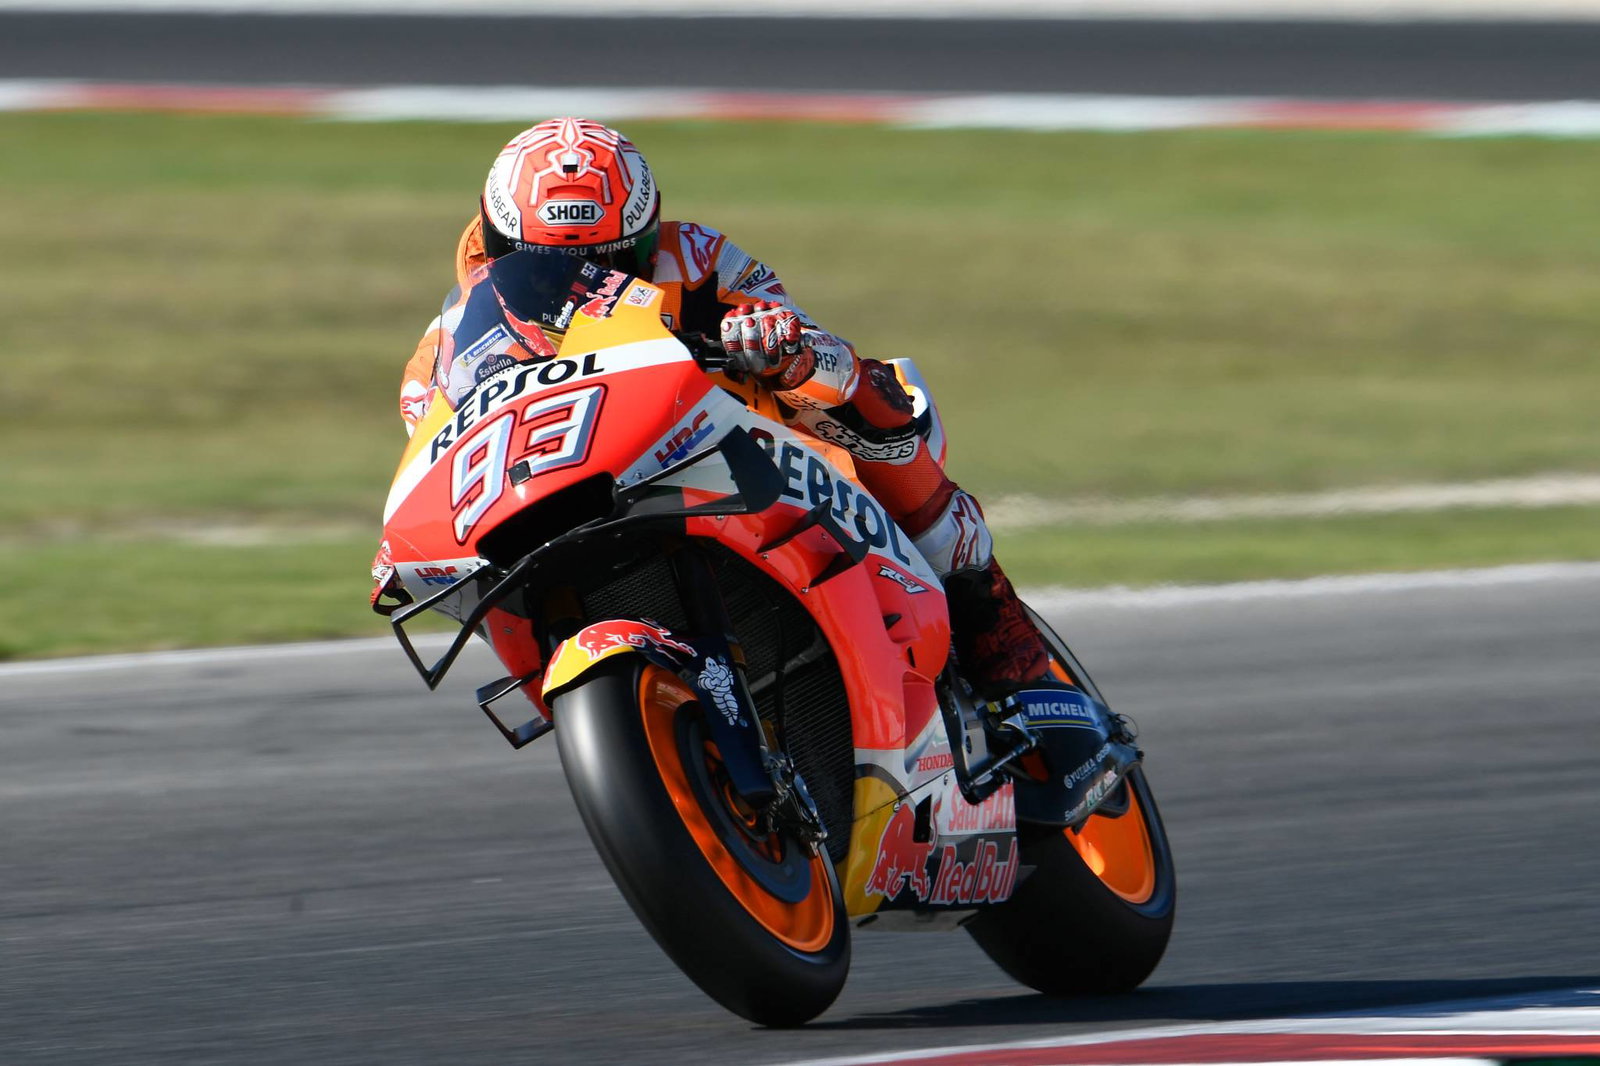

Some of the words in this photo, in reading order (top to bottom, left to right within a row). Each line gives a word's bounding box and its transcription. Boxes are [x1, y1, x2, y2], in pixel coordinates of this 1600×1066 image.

[547, 205, 596, 221] SHOEI
[515, 241, 551, 255] GIVES
[559, 246, 588, 256] YOU
[595, 237, 637, 255] WINGS
[478, 358, 513, 378] Estrella
[430, 353, 605, 465] REPSOL
[450, 382, 609, 546] 93
[1027, 702, 1090, 717] MICHELI
